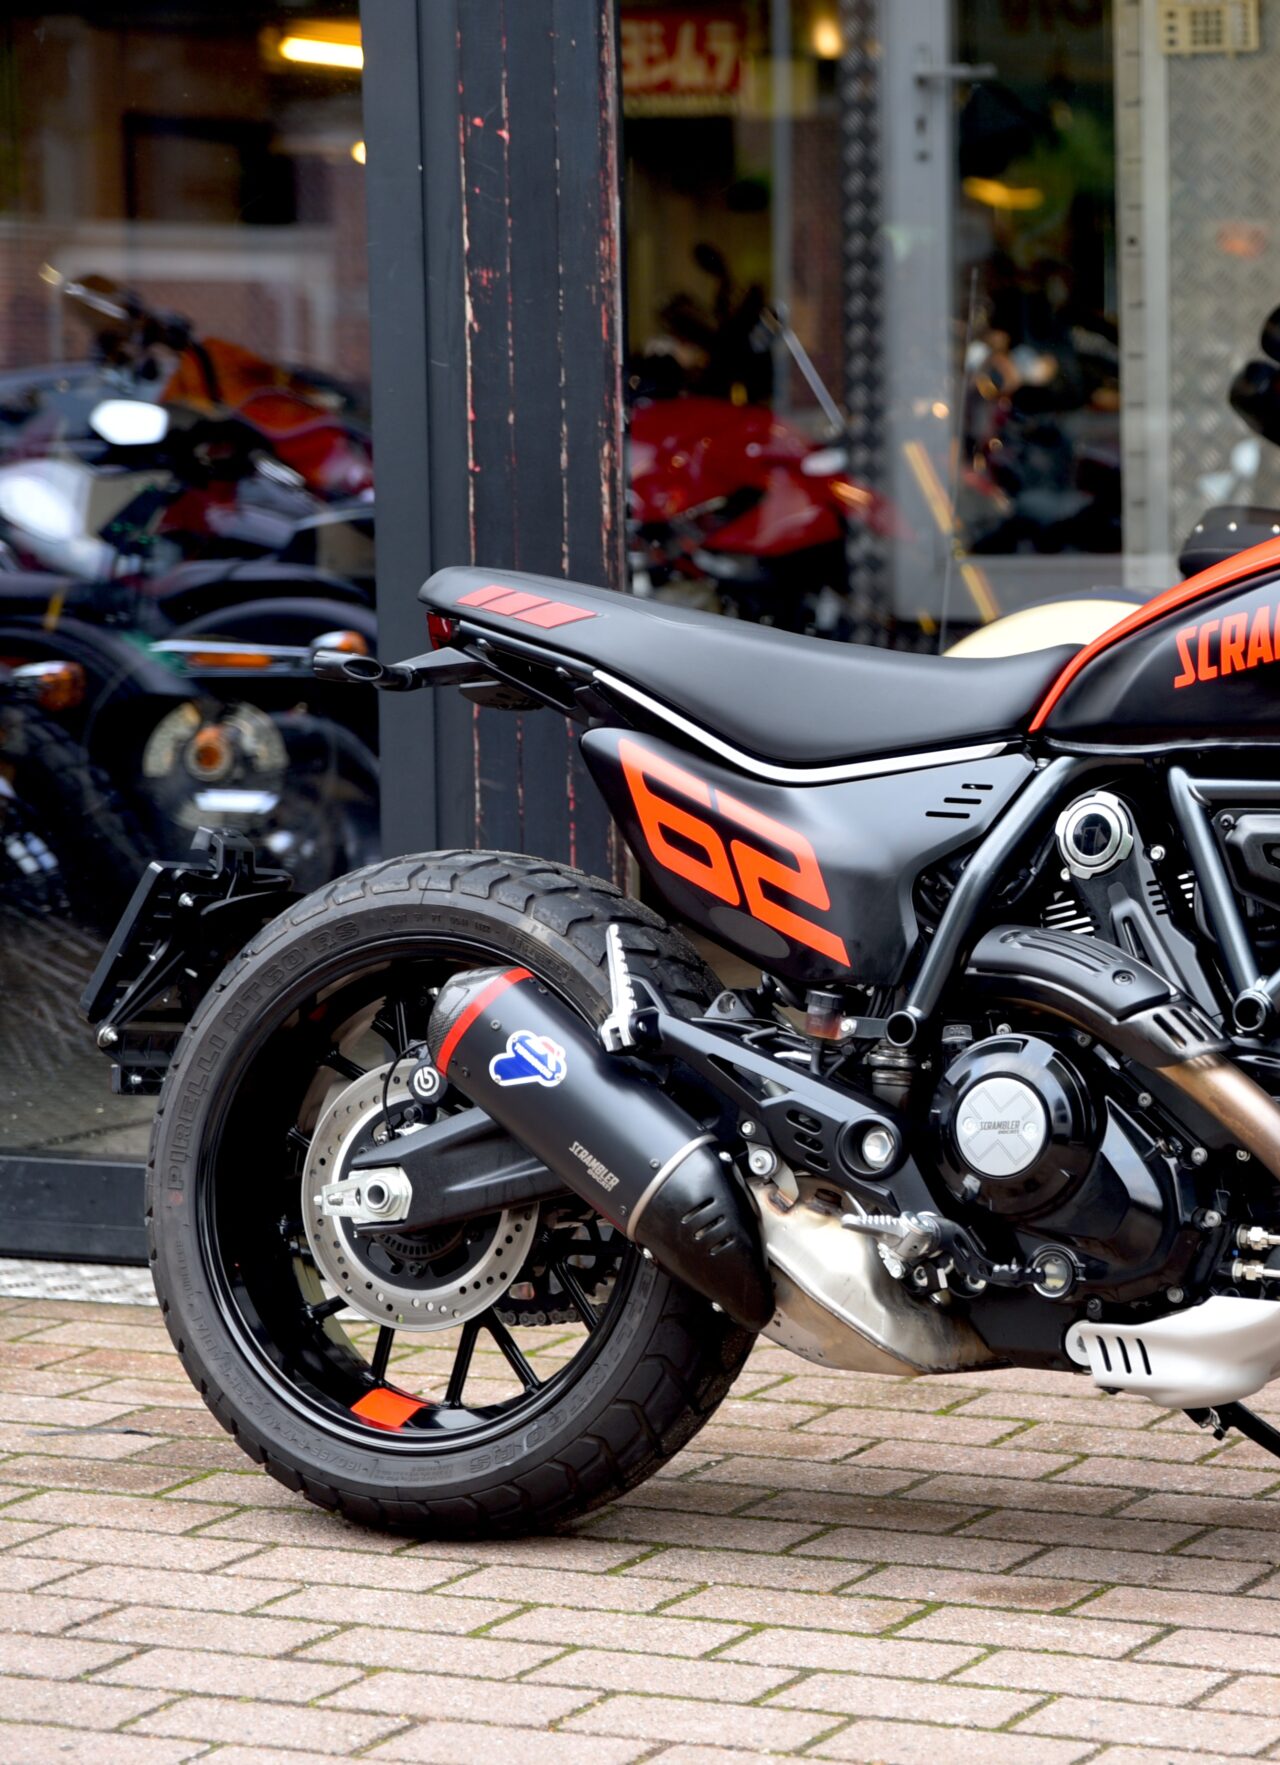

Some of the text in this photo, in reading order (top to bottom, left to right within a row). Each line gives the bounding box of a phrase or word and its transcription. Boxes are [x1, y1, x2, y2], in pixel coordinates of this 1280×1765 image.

[618, 738, 851, 967] 62
[168, 1031, 228, 1191] PIRELLI
[222, 944, 306, 1034] MT60
[980, 1121, 1020, 1130] SCRAMBLER
[568, 1140, 620, 1188] SCRAMBLER
